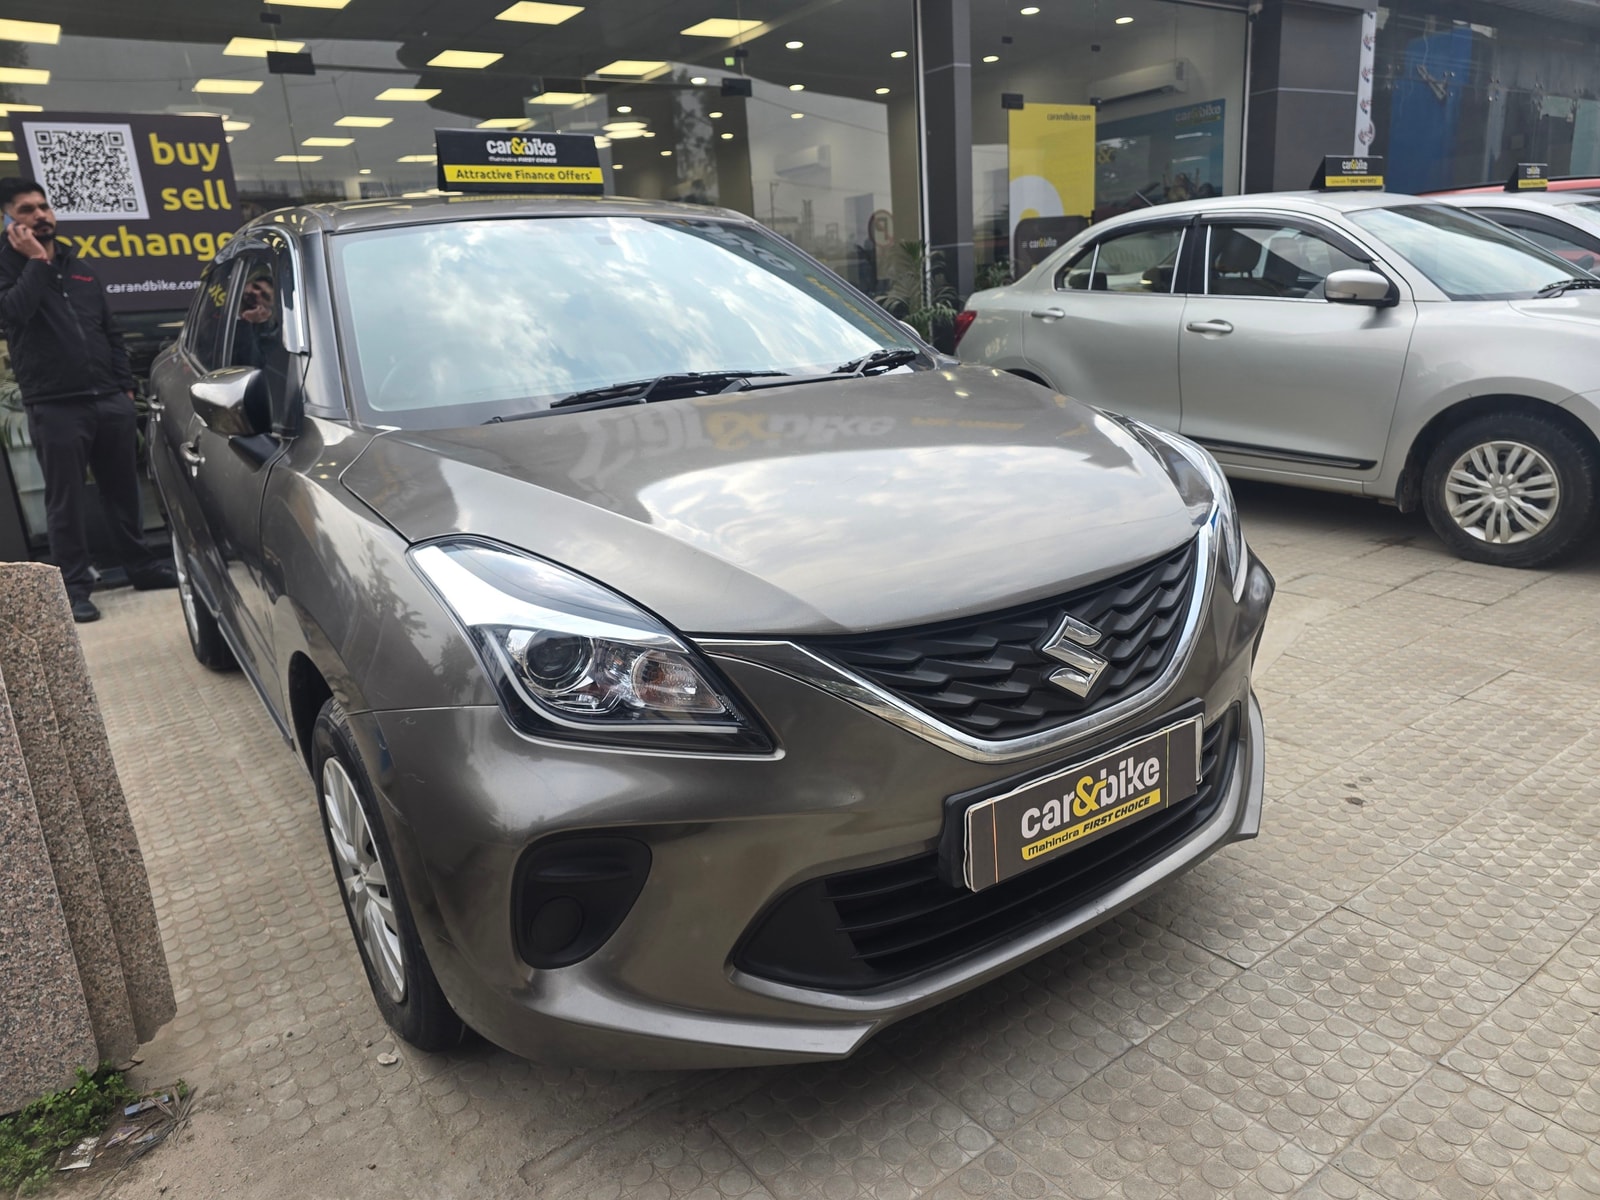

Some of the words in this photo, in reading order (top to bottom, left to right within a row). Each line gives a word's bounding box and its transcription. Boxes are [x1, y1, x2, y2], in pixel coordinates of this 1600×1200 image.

[148, 132, 220, 172] buy
[486, 137, 557, 156] car&bike
[456, 169, 512, 179] Attractive
[515, 170, 555, 180] Finance
[161, 179, 232, 211] sell
[55, 225, 235, 262] xchang
[1021, 756, 1160, 839] car&bike
[1028, 829, 1080, 856] Mahindra
[1082, 813, 1114, 833] FIRST
[1114, 796, 1151, 819] CHOICE
